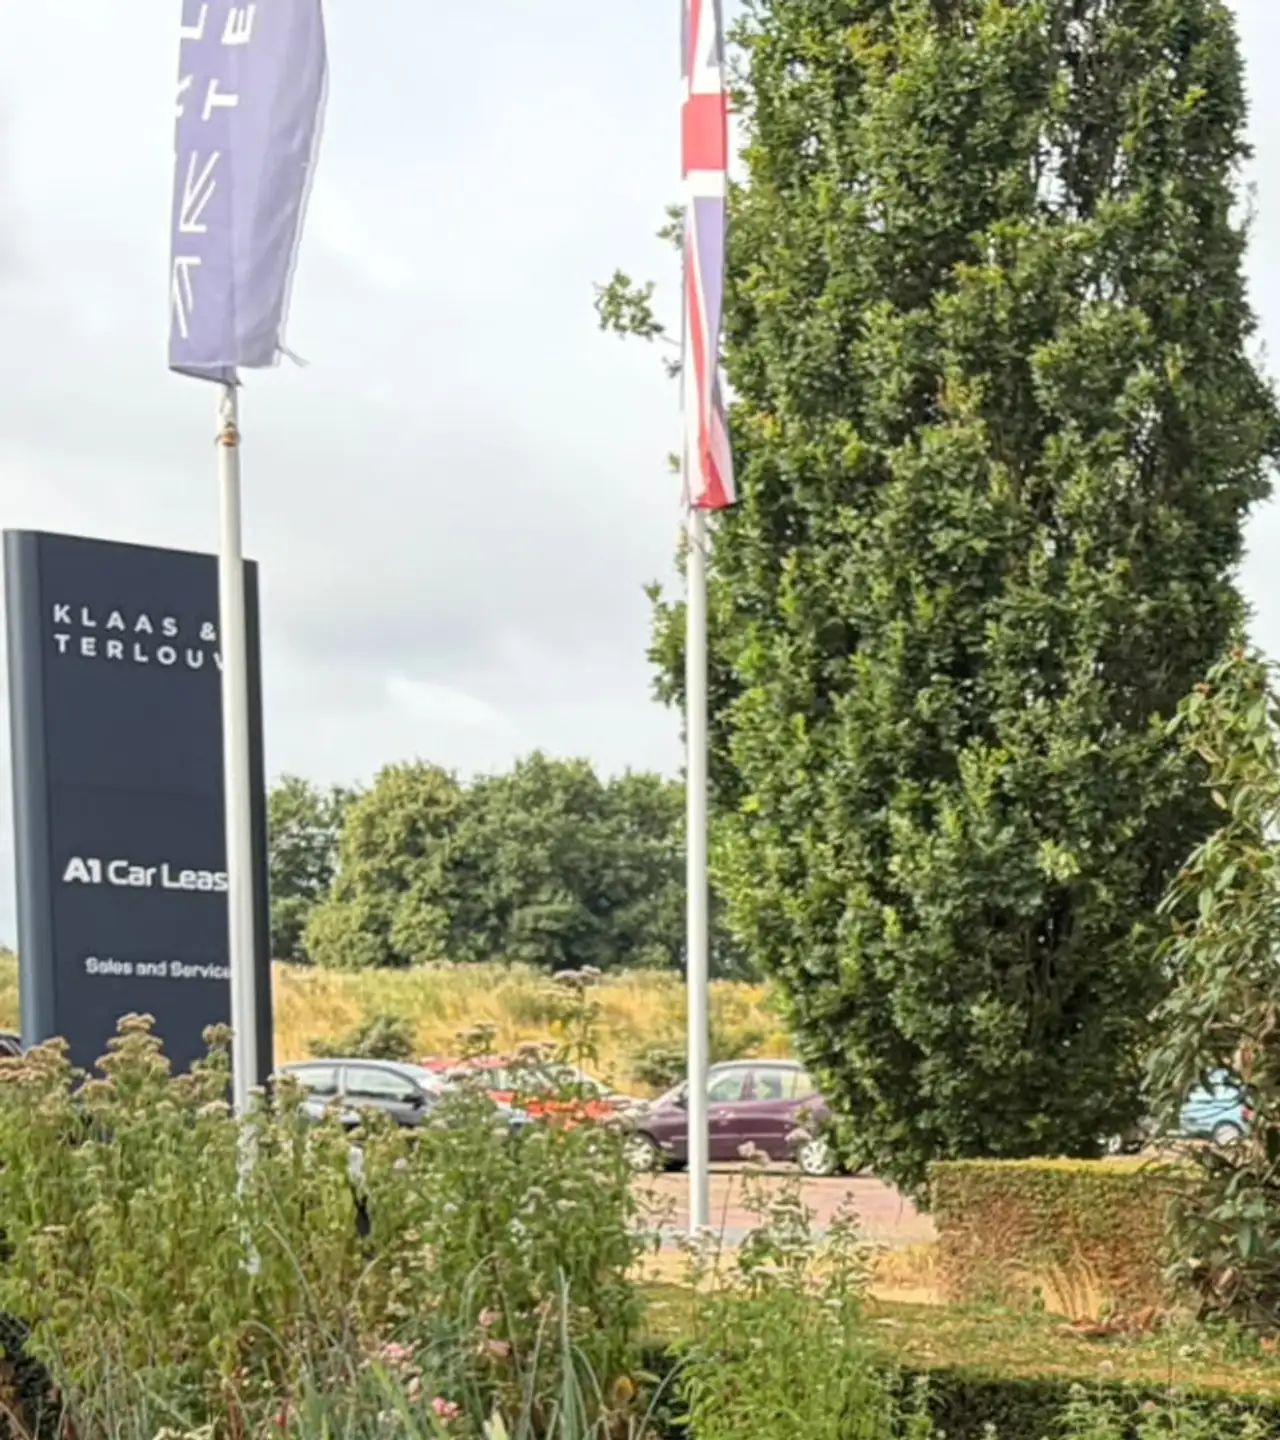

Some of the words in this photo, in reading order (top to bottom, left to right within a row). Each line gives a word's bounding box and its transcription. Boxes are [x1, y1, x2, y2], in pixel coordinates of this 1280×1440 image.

[53, 603, 179, 637] KLAAS
[199, 621, 217, 642] &
[62, 856, 102, 883] A1
[107, 860, 157, 888] Car
[85, 956, 133, 975] Sales
[136, 960, 168, 977] and
